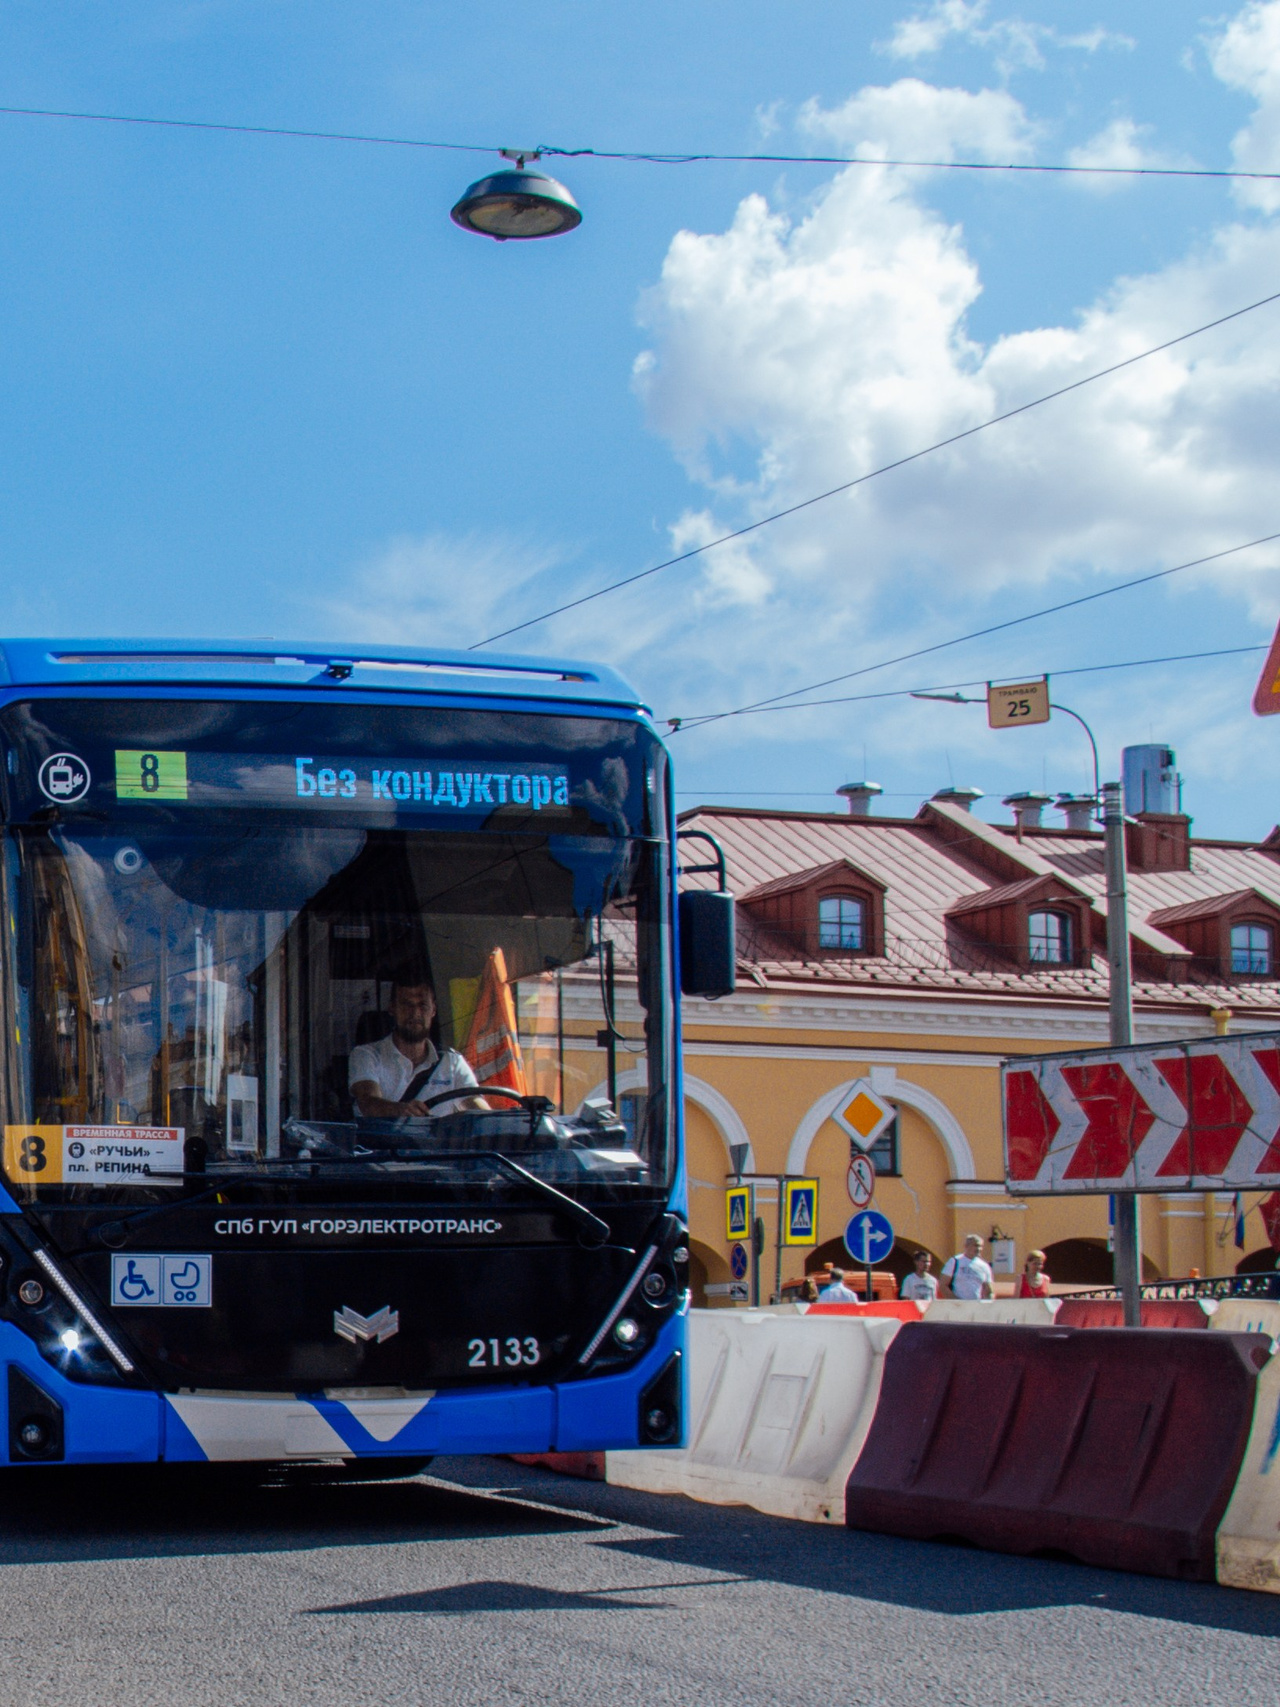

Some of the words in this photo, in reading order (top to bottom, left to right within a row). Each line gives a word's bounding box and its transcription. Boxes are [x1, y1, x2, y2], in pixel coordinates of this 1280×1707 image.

[1007, 699, 1032, 718] 25
[140, 753, 160, 792] 8
[295, 757, 357, 798] Без
[371, 768, 569, 810] кондуктора
[72, 1128, 133, 1139] ВРЕМЕННАЯ
[135, 1129, 171, 1140] ТРАССА
[19, 1135, 48, 1173] 8
[89, 1145, 151, 1158] «РУЧЬИ»
[68, 1163, 90, 1173] пл.
[94, 1161, 151, 1174] РЕПИНА
[214, 1218, 254, 1234] СПб
[258, 1219, 297, 1234] ГУП
[301, 1219, 503, 1234] «ГОРЭЛЕКТРОТРАНС»
[467, 1336, 541, 1368] 2133
